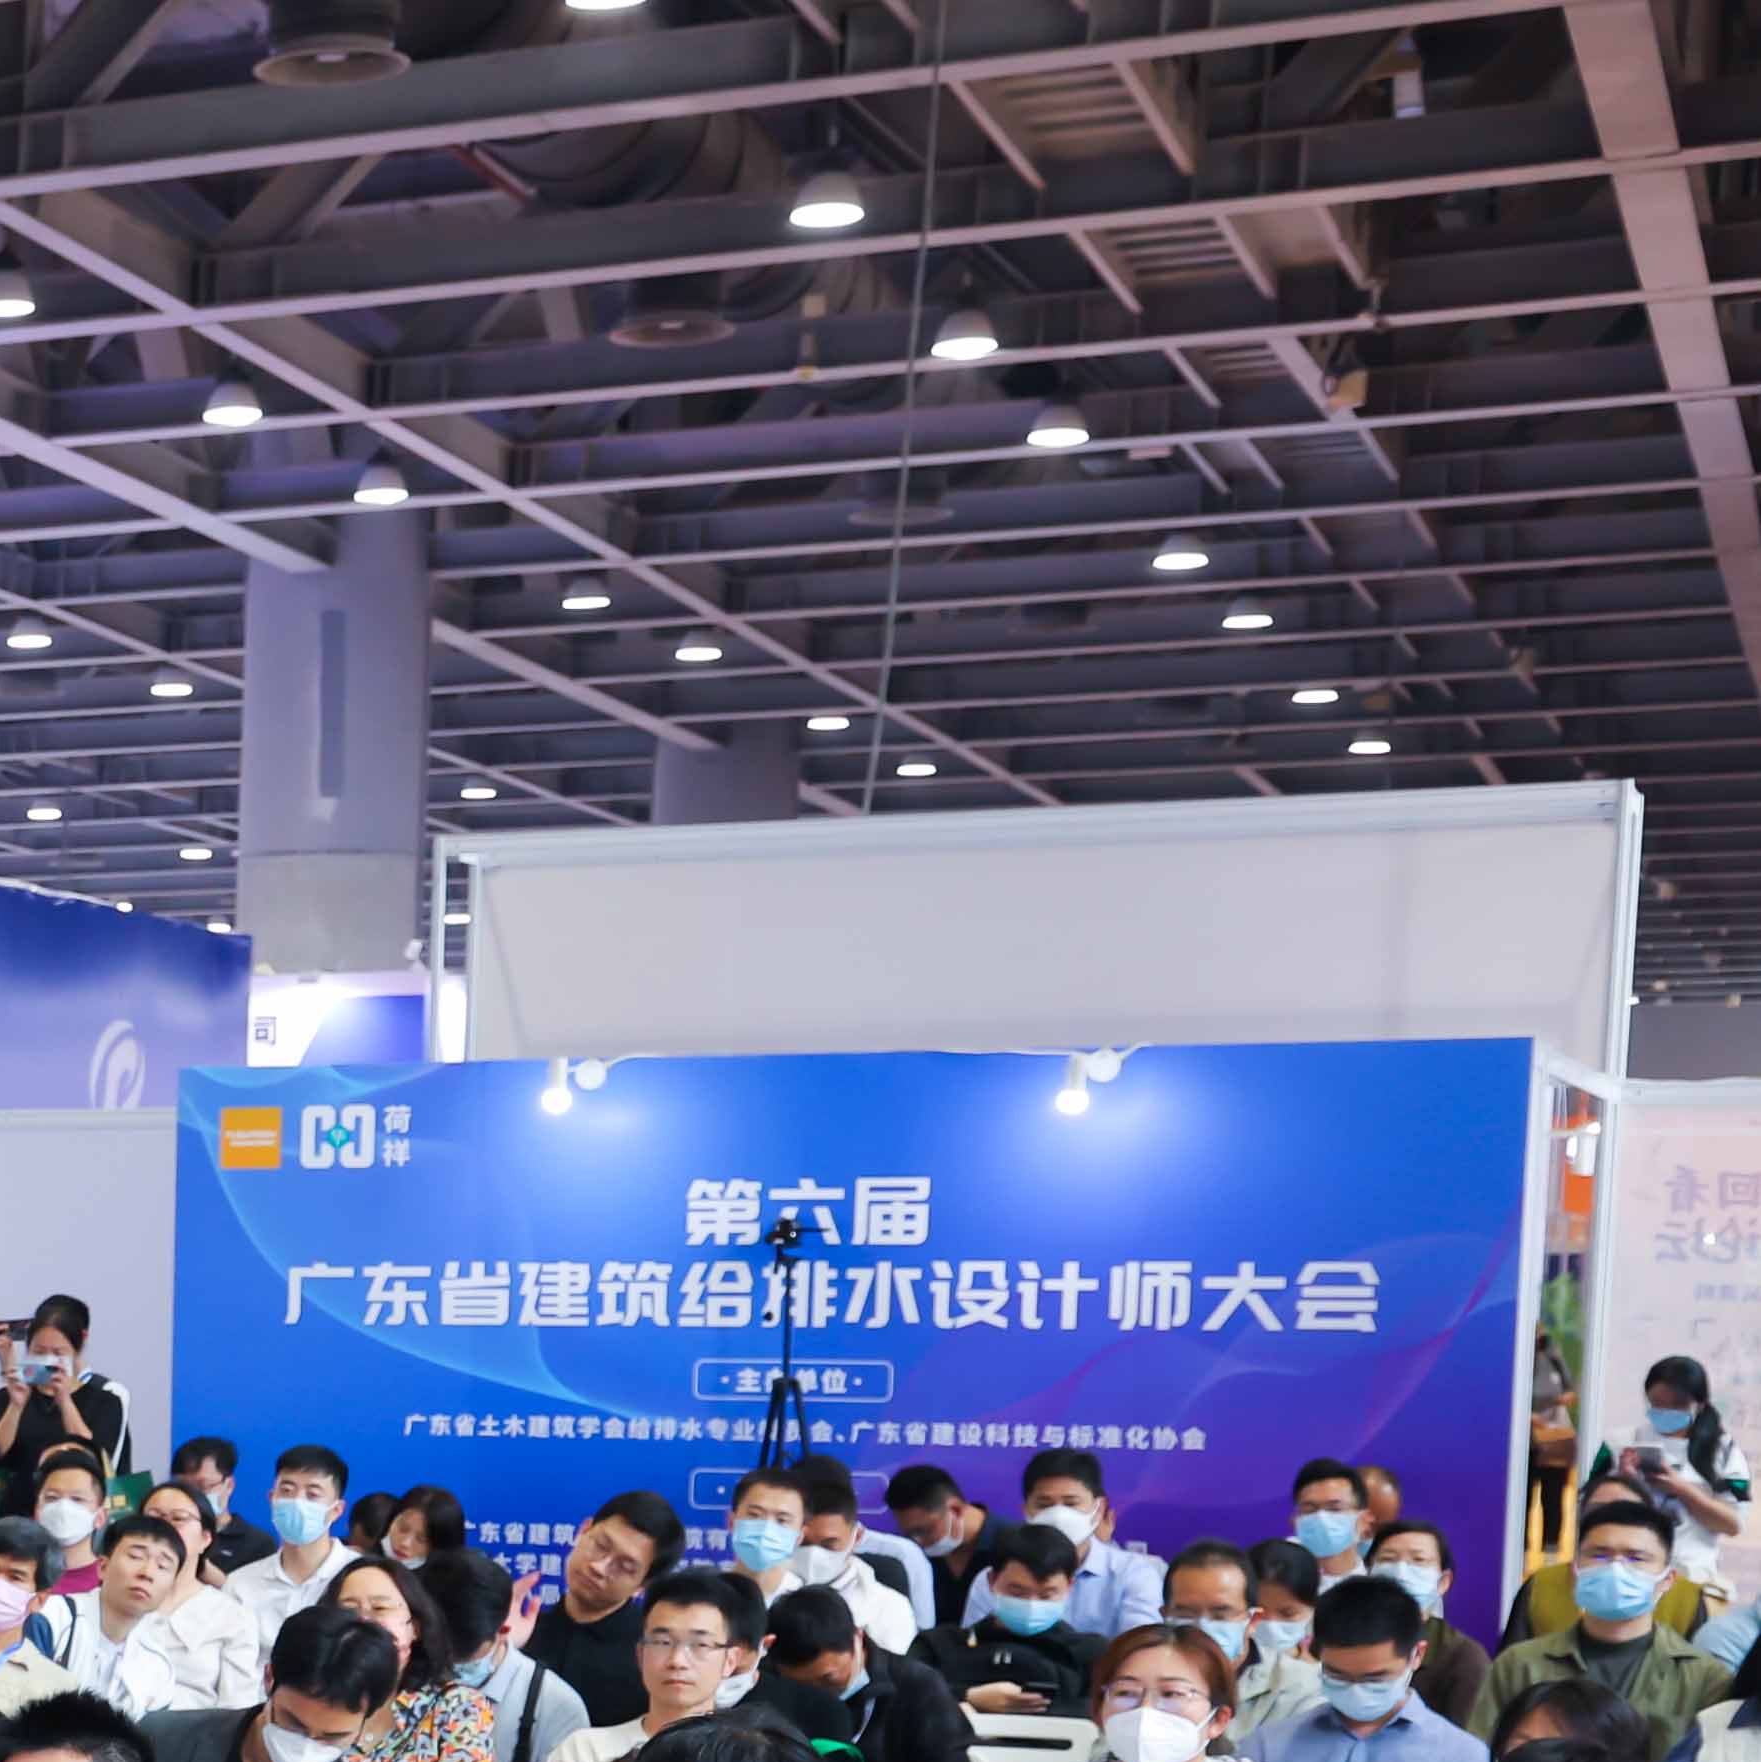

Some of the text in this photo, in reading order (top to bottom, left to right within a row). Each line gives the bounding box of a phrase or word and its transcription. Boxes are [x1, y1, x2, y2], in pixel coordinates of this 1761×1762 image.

[383, 1104, 411, 1167] 荷祥
[685, 1176, 932, 1246] 第六届
[284, 1260, 1380, 1332] 广东省建筑给排水设计师大会
[464, 1520, 576, 1546] 东省建筑
